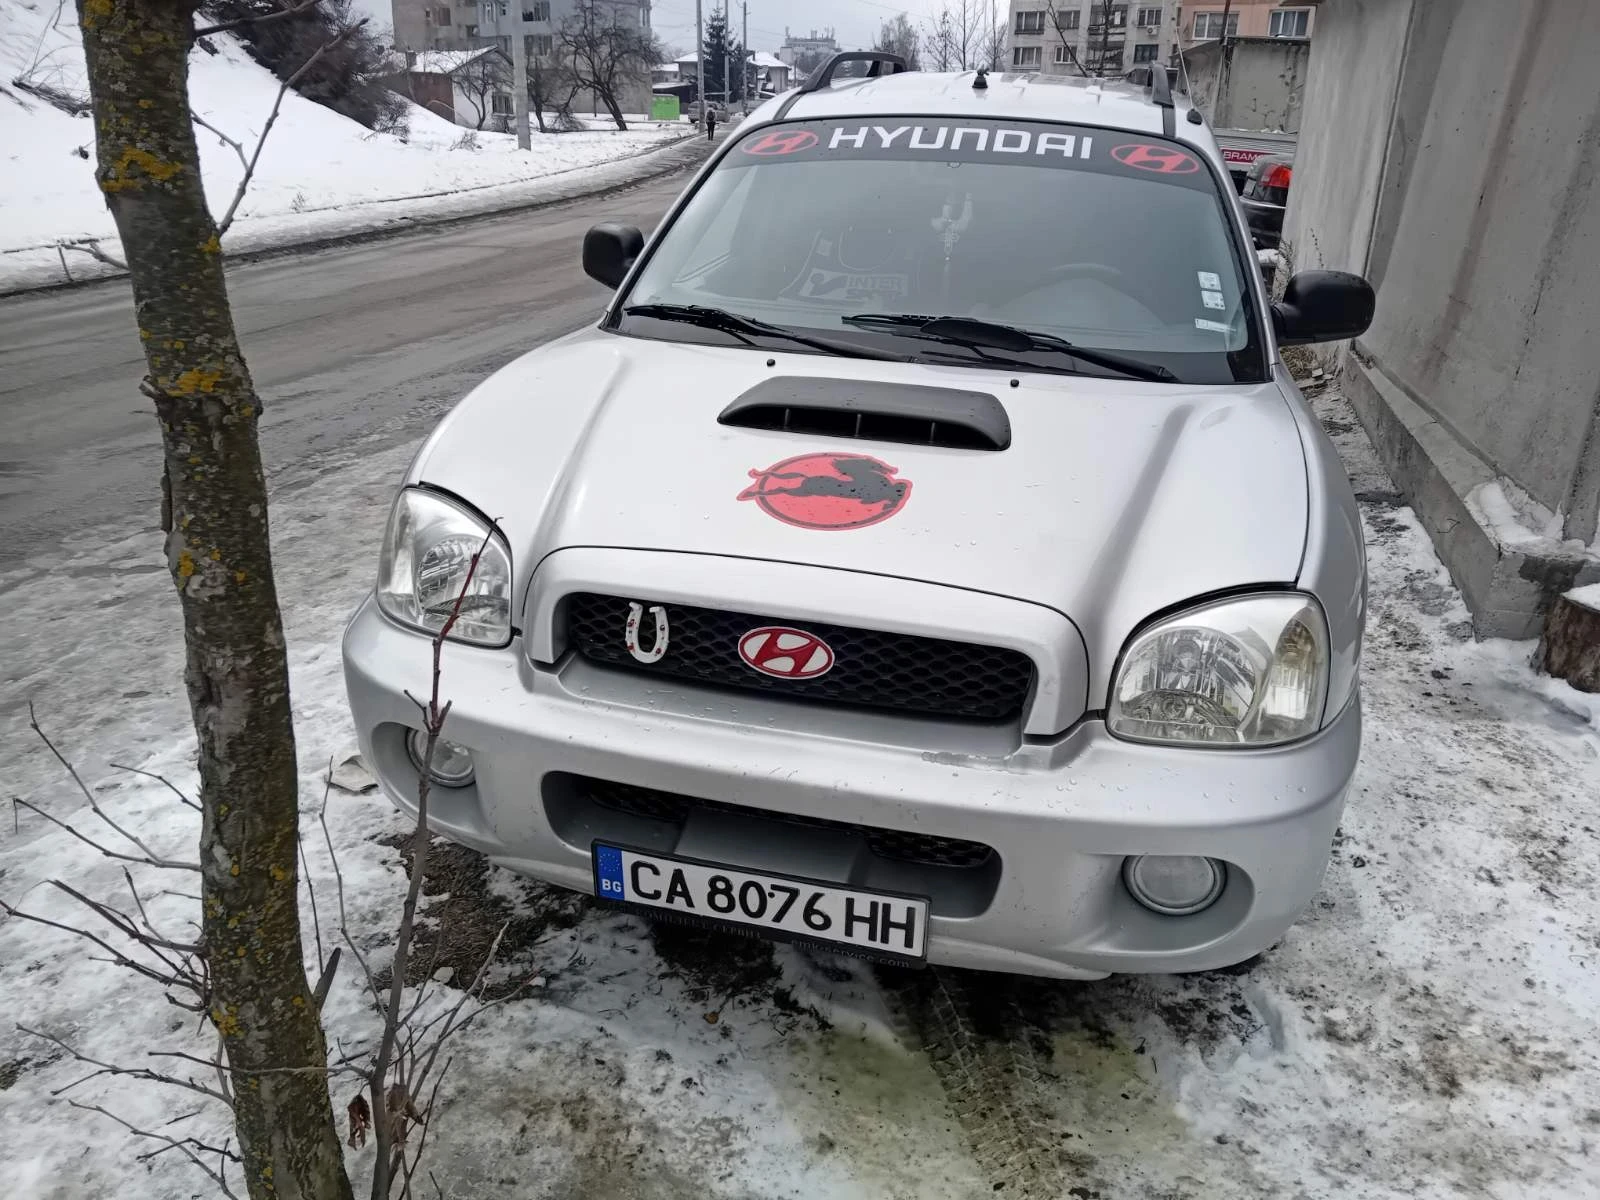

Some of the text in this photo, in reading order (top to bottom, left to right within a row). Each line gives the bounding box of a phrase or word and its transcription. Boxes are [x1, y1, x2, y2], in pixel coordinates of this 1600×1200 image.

[828, 126, 1092, 159] HYUNDAI
[602, 879, 622, 893] BG
[630, 860, 695, 908] CA
[707, 875, 833, 931] 8076
[844, 897, 916, 949] HH
